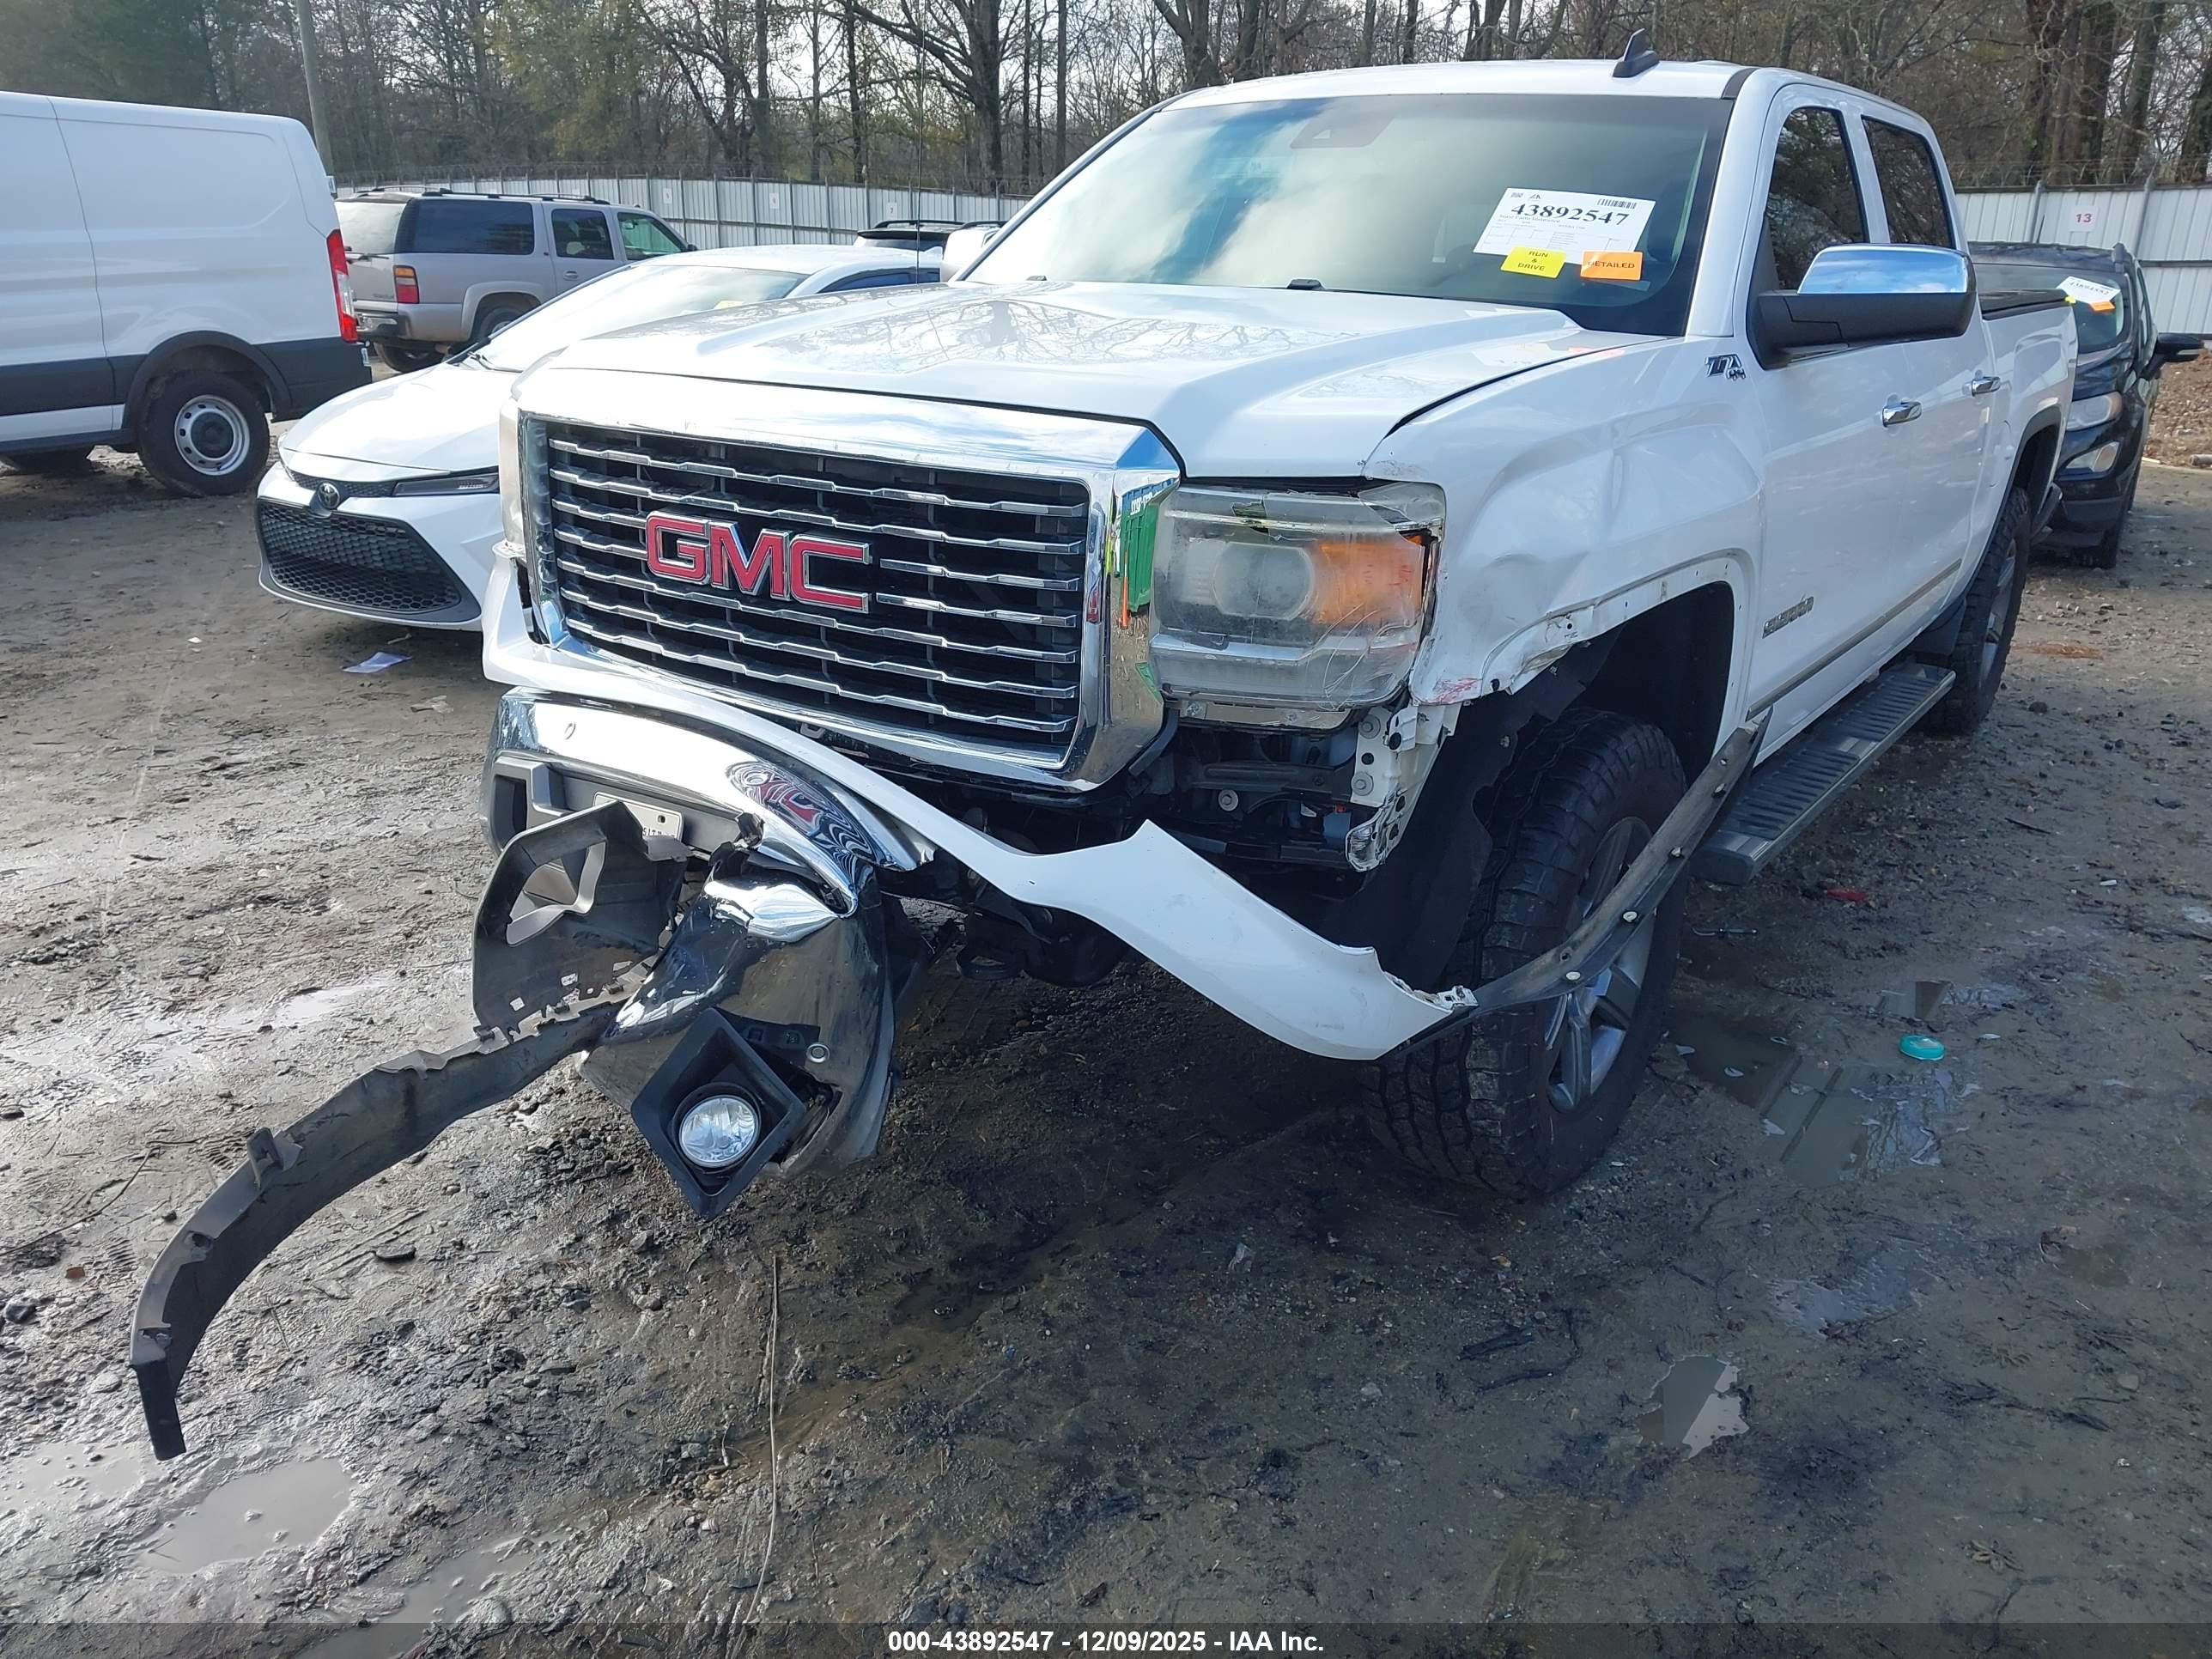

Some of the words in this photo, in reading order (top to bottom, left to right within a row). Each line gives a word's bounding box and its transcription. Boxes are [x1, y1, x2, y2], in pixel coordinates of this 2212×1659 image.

[1510, 203, 1631, 226] 43892547
[2075, 212, 2093, 223] 13
[1517, 262, 1546, 271] DRIVE
[646, 510, 872, 615] GMC
